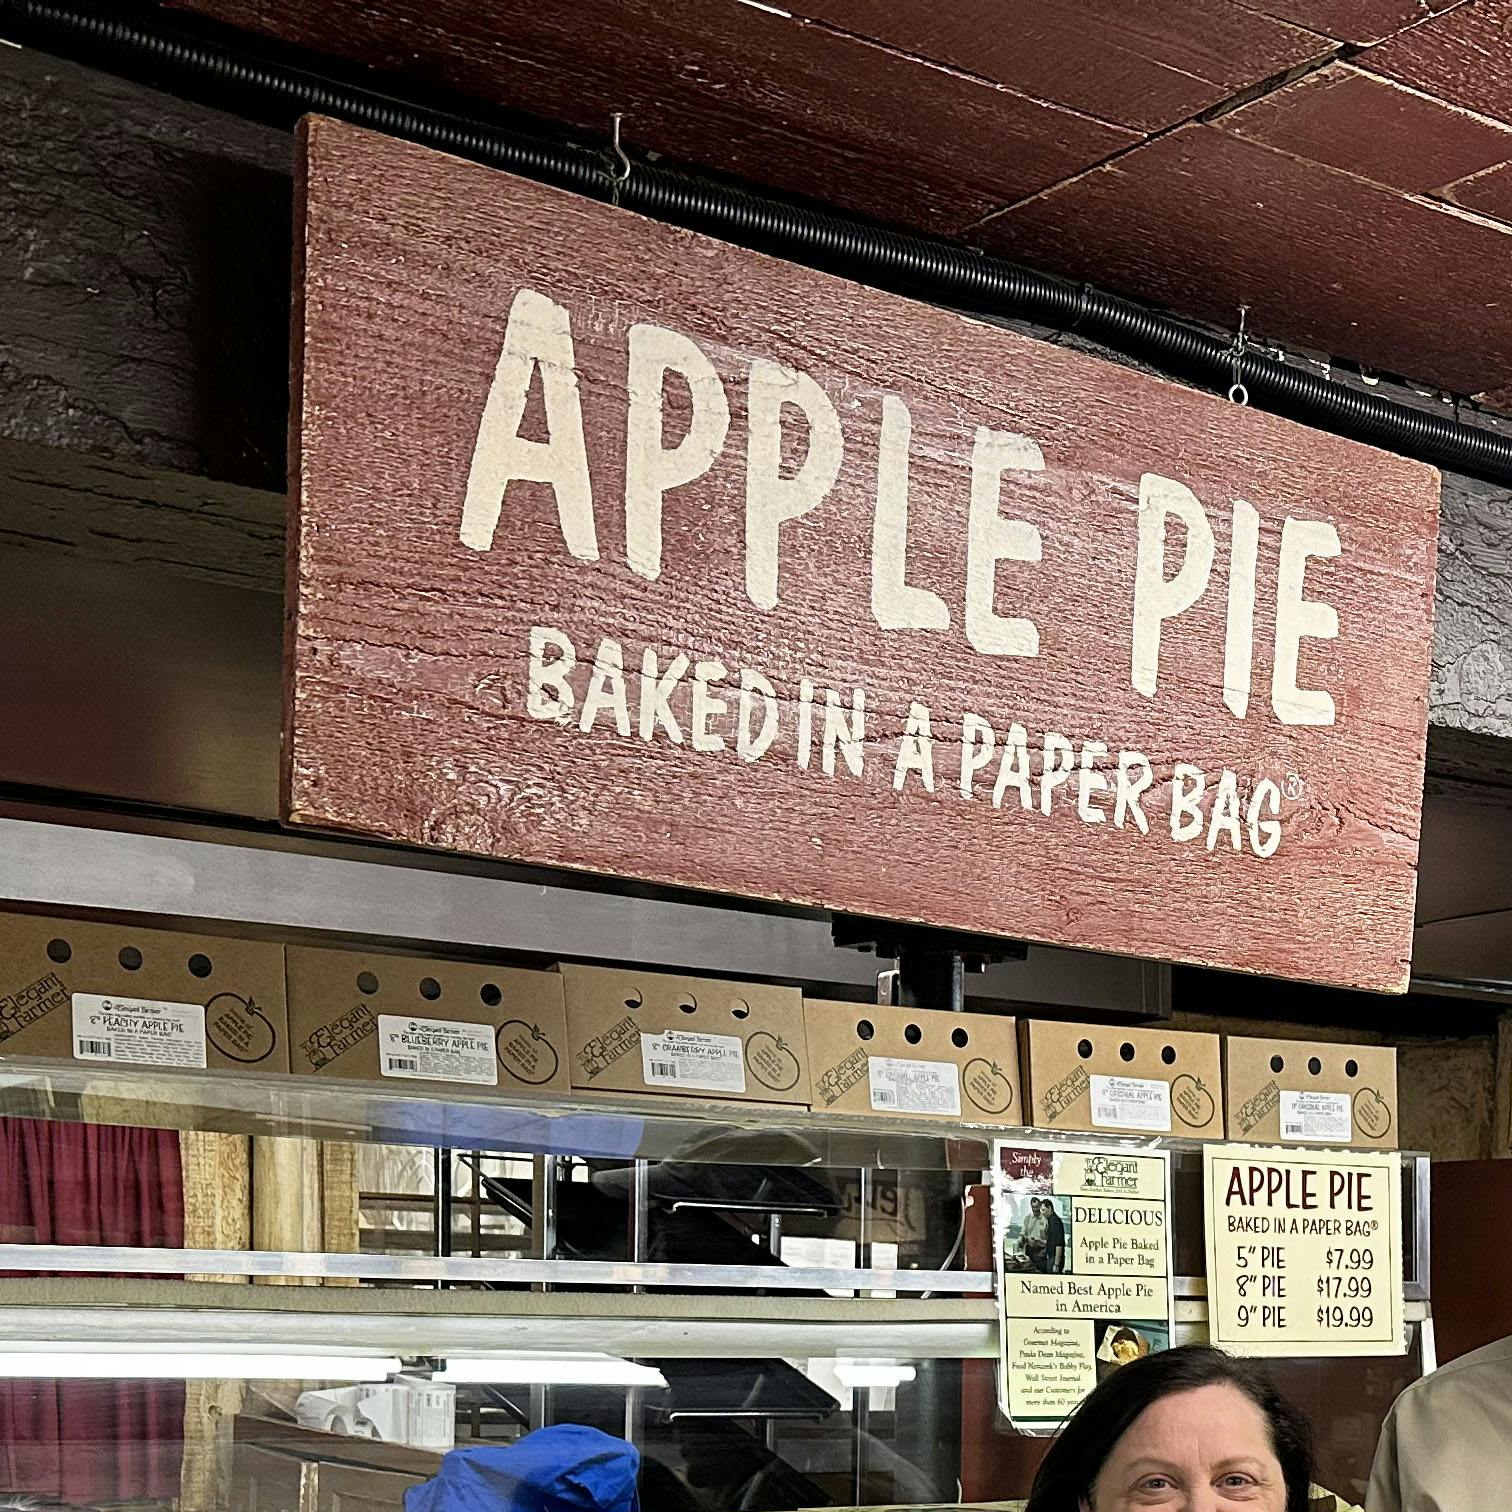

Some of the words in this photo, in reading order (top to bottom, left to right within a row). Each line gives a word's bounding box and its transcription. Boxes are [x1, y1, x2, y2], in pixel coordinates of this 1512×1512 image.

[460, 289, 1045, 658] APPLE
[1130, 471, 1342, 727] PIE
[527, 627, 778, 762] BAKED
[796, 679, 867, 777] IN
[894, 702, 936, 793] A
[959, 714, 1153, 835] PAPER
[1092, 1157, 1138, 1176] Elegant
[1100, 1174, 1139, 1190] Farmer
[1225, 1166, 1319, 1210] APPLE
[1329, 1170, 1374, 1212] PIE
[1074, 1206, 1163, 1227] DELICIOUS
[1227, 1216, 1270, 1233] BAKED
[1273, 1217, 1286, 1234] IN
[1290, 1218, 1299, 1234] A
[1302, 1218, 1342, 1236] PAPER
[1080, 1237, 1110, 1250] Apple
[1112, 1238, 1128, 1250] Pie
[1130, 1239, 1160, 1251] Baked
[1085, 1254, 1095, 1265] in
[1098, 1256, 1105, 1265] a
[1107, 1253, 1135, 1268] Paper
[1137, 1254, 1155, 1269] Bag
[1236, 1245, 1256, 1268] 5"
[1261, 1246, 1287, 1269] PIE
[1325, 1247, 1374, 1270] $7.99
[1020, 1280, 1064, 1296] Named
[1067, 1281, 1093, 1296] Best
[1097, 1282, 1132, 1300] Apple
[1136, 1283, 1154, 1297] Pie
[1236, 1274, 1257, 1297] 8"
[1262, 1275, 1287, 1298] PIE
[1316, 1276, 1372, 1298] $17.99
[1056, 1300, 1068, 1313] in
[1072, 1300, 1122, 1314] America
[1237, 1304, 1258, 1327] 9"
[1262, 1305, 1287, 1328] PIE
[1316, 1305, 1374, 1328] $19.99
